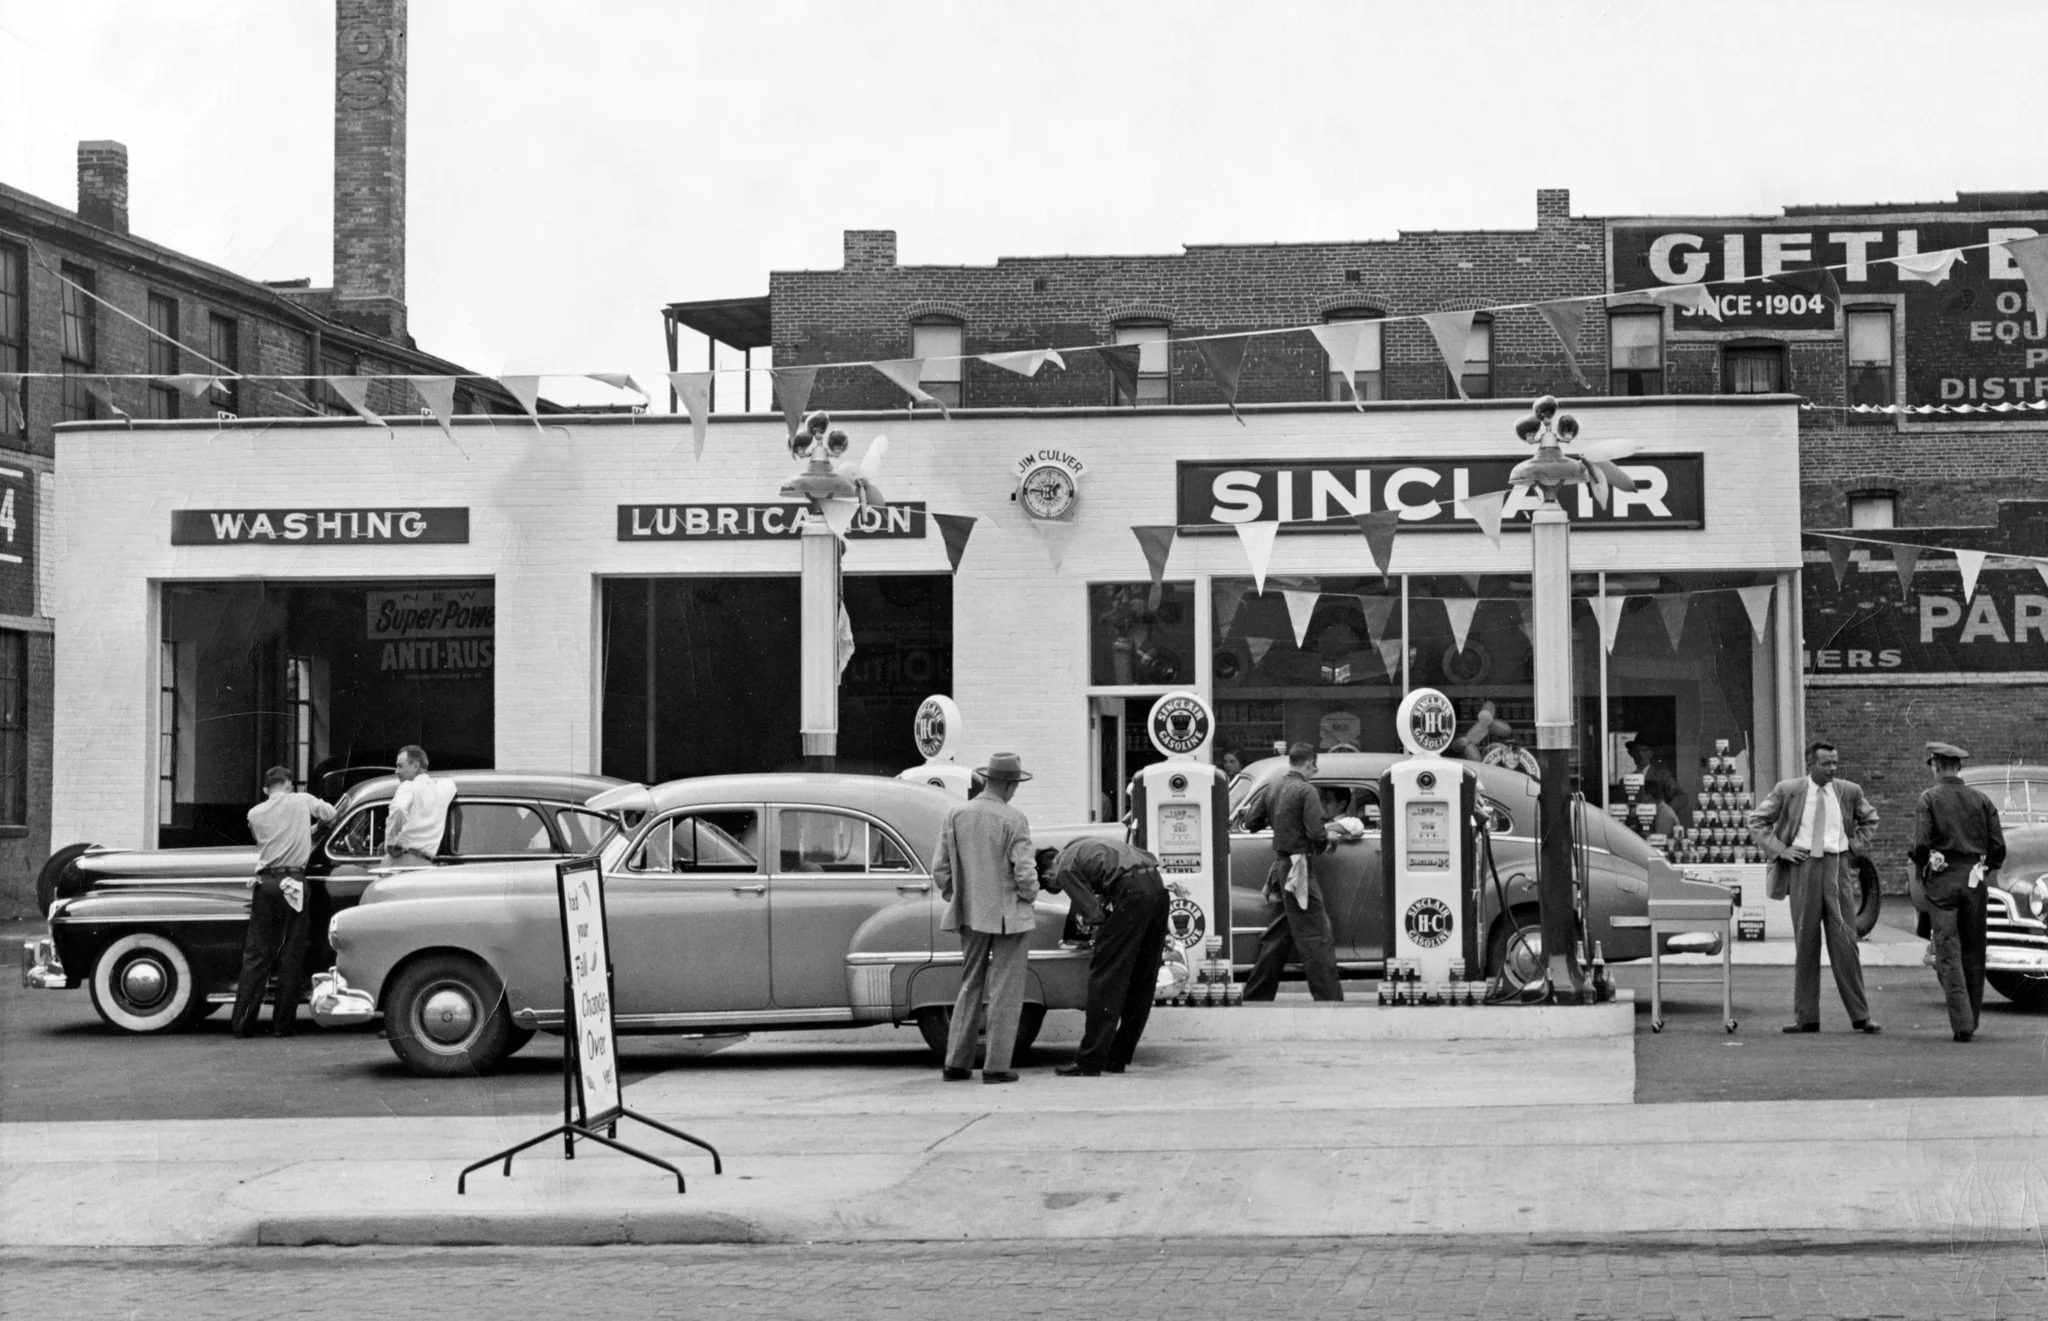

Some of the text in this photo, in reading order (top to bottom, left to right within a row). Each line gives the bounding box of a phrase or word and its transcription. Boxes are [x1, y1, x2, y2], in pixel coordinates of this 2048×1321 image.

[1765, 293, 1825, 315] 1904
[1018, 450, 1083, 474] JIM CULVER
[210, 511, 427, 540] WASHING
[632, 505, 911, 536] LUBRICAON
[403, 591, 476, 602] NEW
[1158, 700, 1204, 722] SINCLAIR
[1414, 697, 1451, 718] SINCLAIR
[1425, 711, 1447, 733] H-C
[1158, 730, 1204, 750] GASOLINE
[1414, 727, 1451, 748] GASOLINE
[1170, 900, 1202, 920] CLAIR
[1407, 898, 1450, 917] SINCLAIR
[1418, 914, 1443, 933] H-C
[1408, 928, 1452, 948] GASOLINE
[587, 1028, 606, 1061] Over
